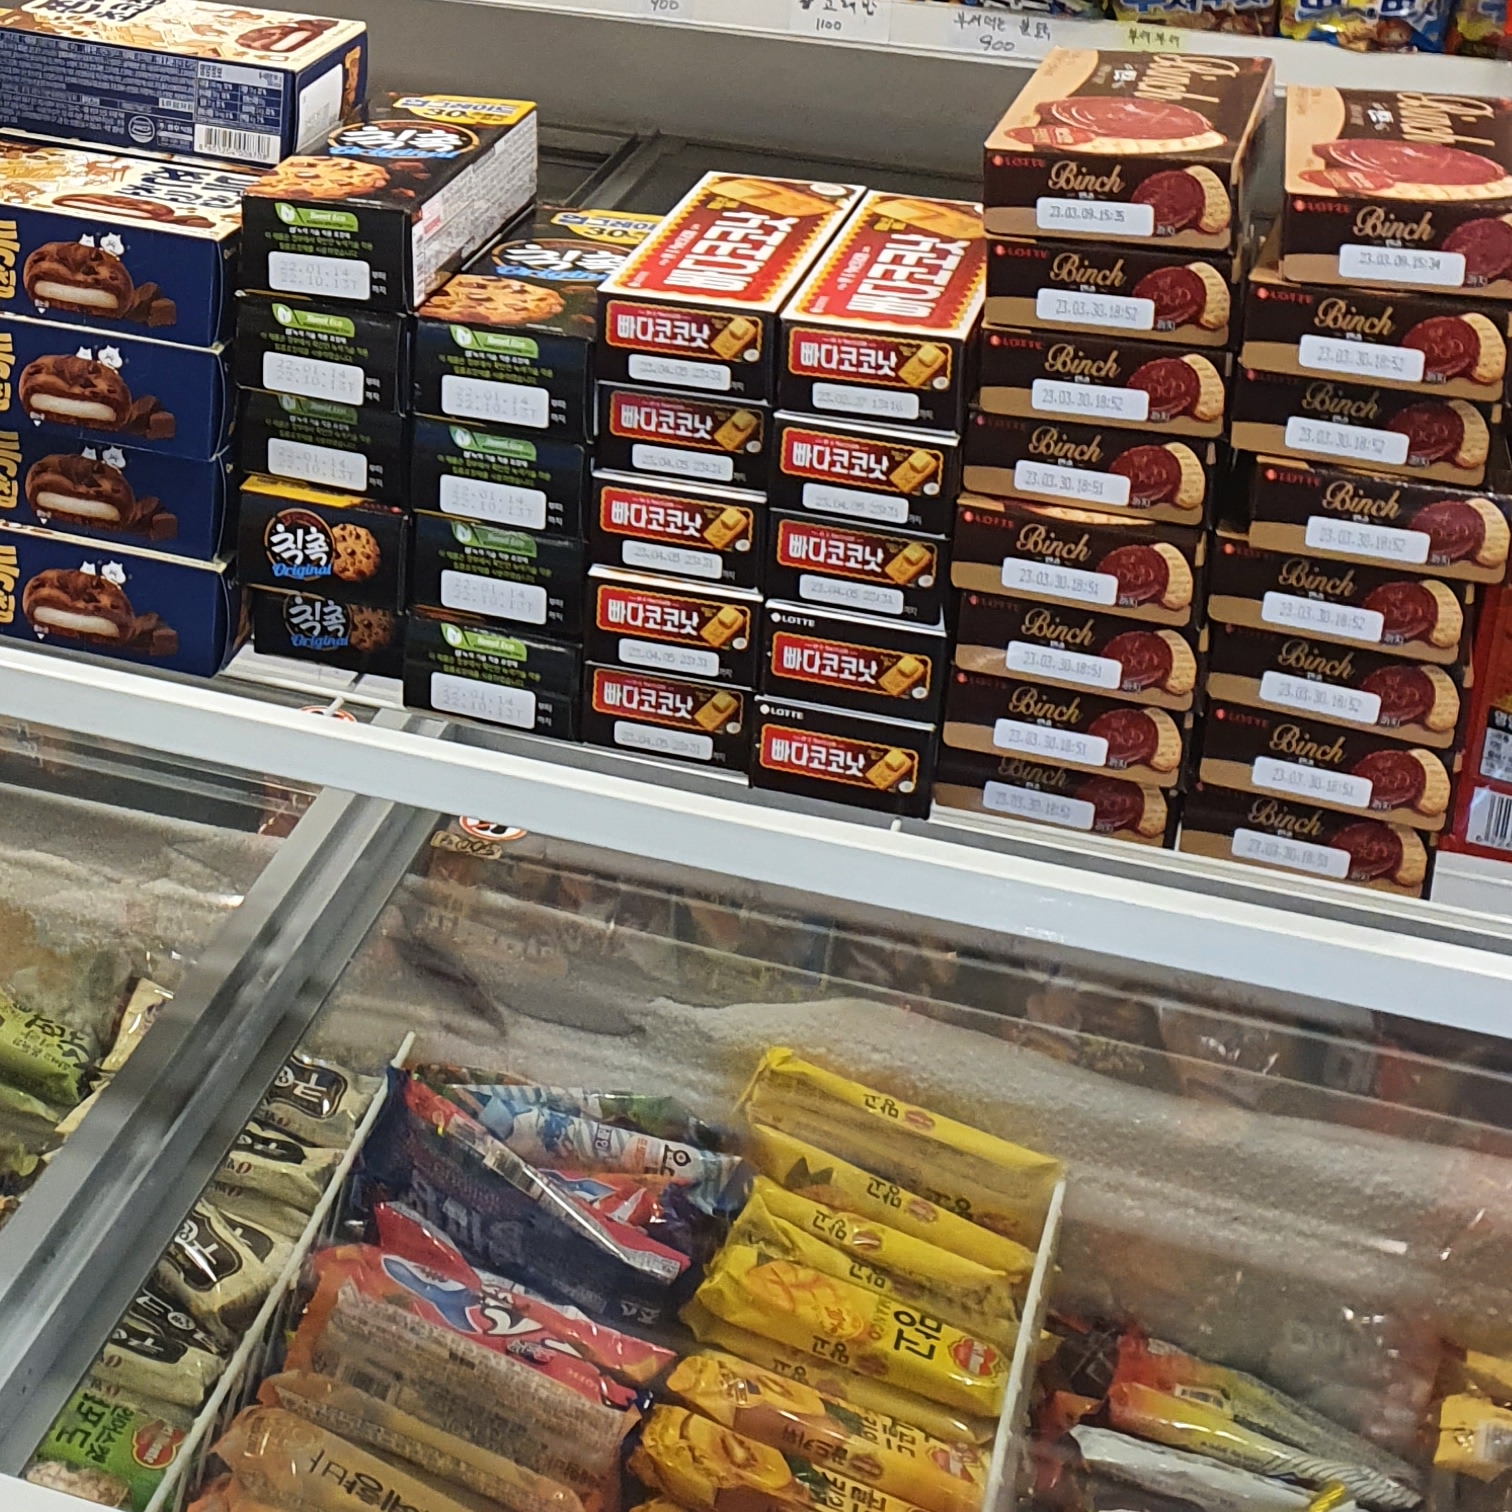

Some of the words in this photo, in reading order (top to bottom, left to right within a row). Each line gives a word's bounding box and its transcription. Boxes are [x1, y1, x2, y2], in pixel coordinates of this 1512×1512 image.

[814, 18, 843, 33] 1100
[979, 35, 1016, 52] 900
[337, 124, 464, 152] 칙촉
[1048, 160, 1124, 193] Binch
[1353, 205, 1435, 241] Binch
[1049, 252, 1126, 285] Binch
[616, 314, 710, 350] 빠다코코낫
[1314, 297, 1394, 335] Binch
[800, 341, 897, 378] 빠다코코낫
[1045, 344, 1120, 377] Binch
[621, 404, 713, 440] 빠다코코낫
[792, 441, 889, 479] 빠다코코낫
[1322, 482, 1400, 518] Binch
[610, 501, 703, 538] 빠다코코낫
[269, 524, 333, 566] 칙촉
[788, 534, 884, 572] 빠다코코낫
[1015, 524, 1092, 561] Binch
[272, 562, 332, 579] Original
[288, 598, 347, 635] 칙촉
[607, 600, 699, 636] 빠다코코낫
[782, 615, 816, 627] LOTTE
[1021, 608, 1095, 645] Binch
[290, 632, 350, 647] Original
[603, 681, 693, 719] 빠다코코낫
[770, 707, 804, 719] LOTTE
[893, 1309, 943, 1360] 망고
